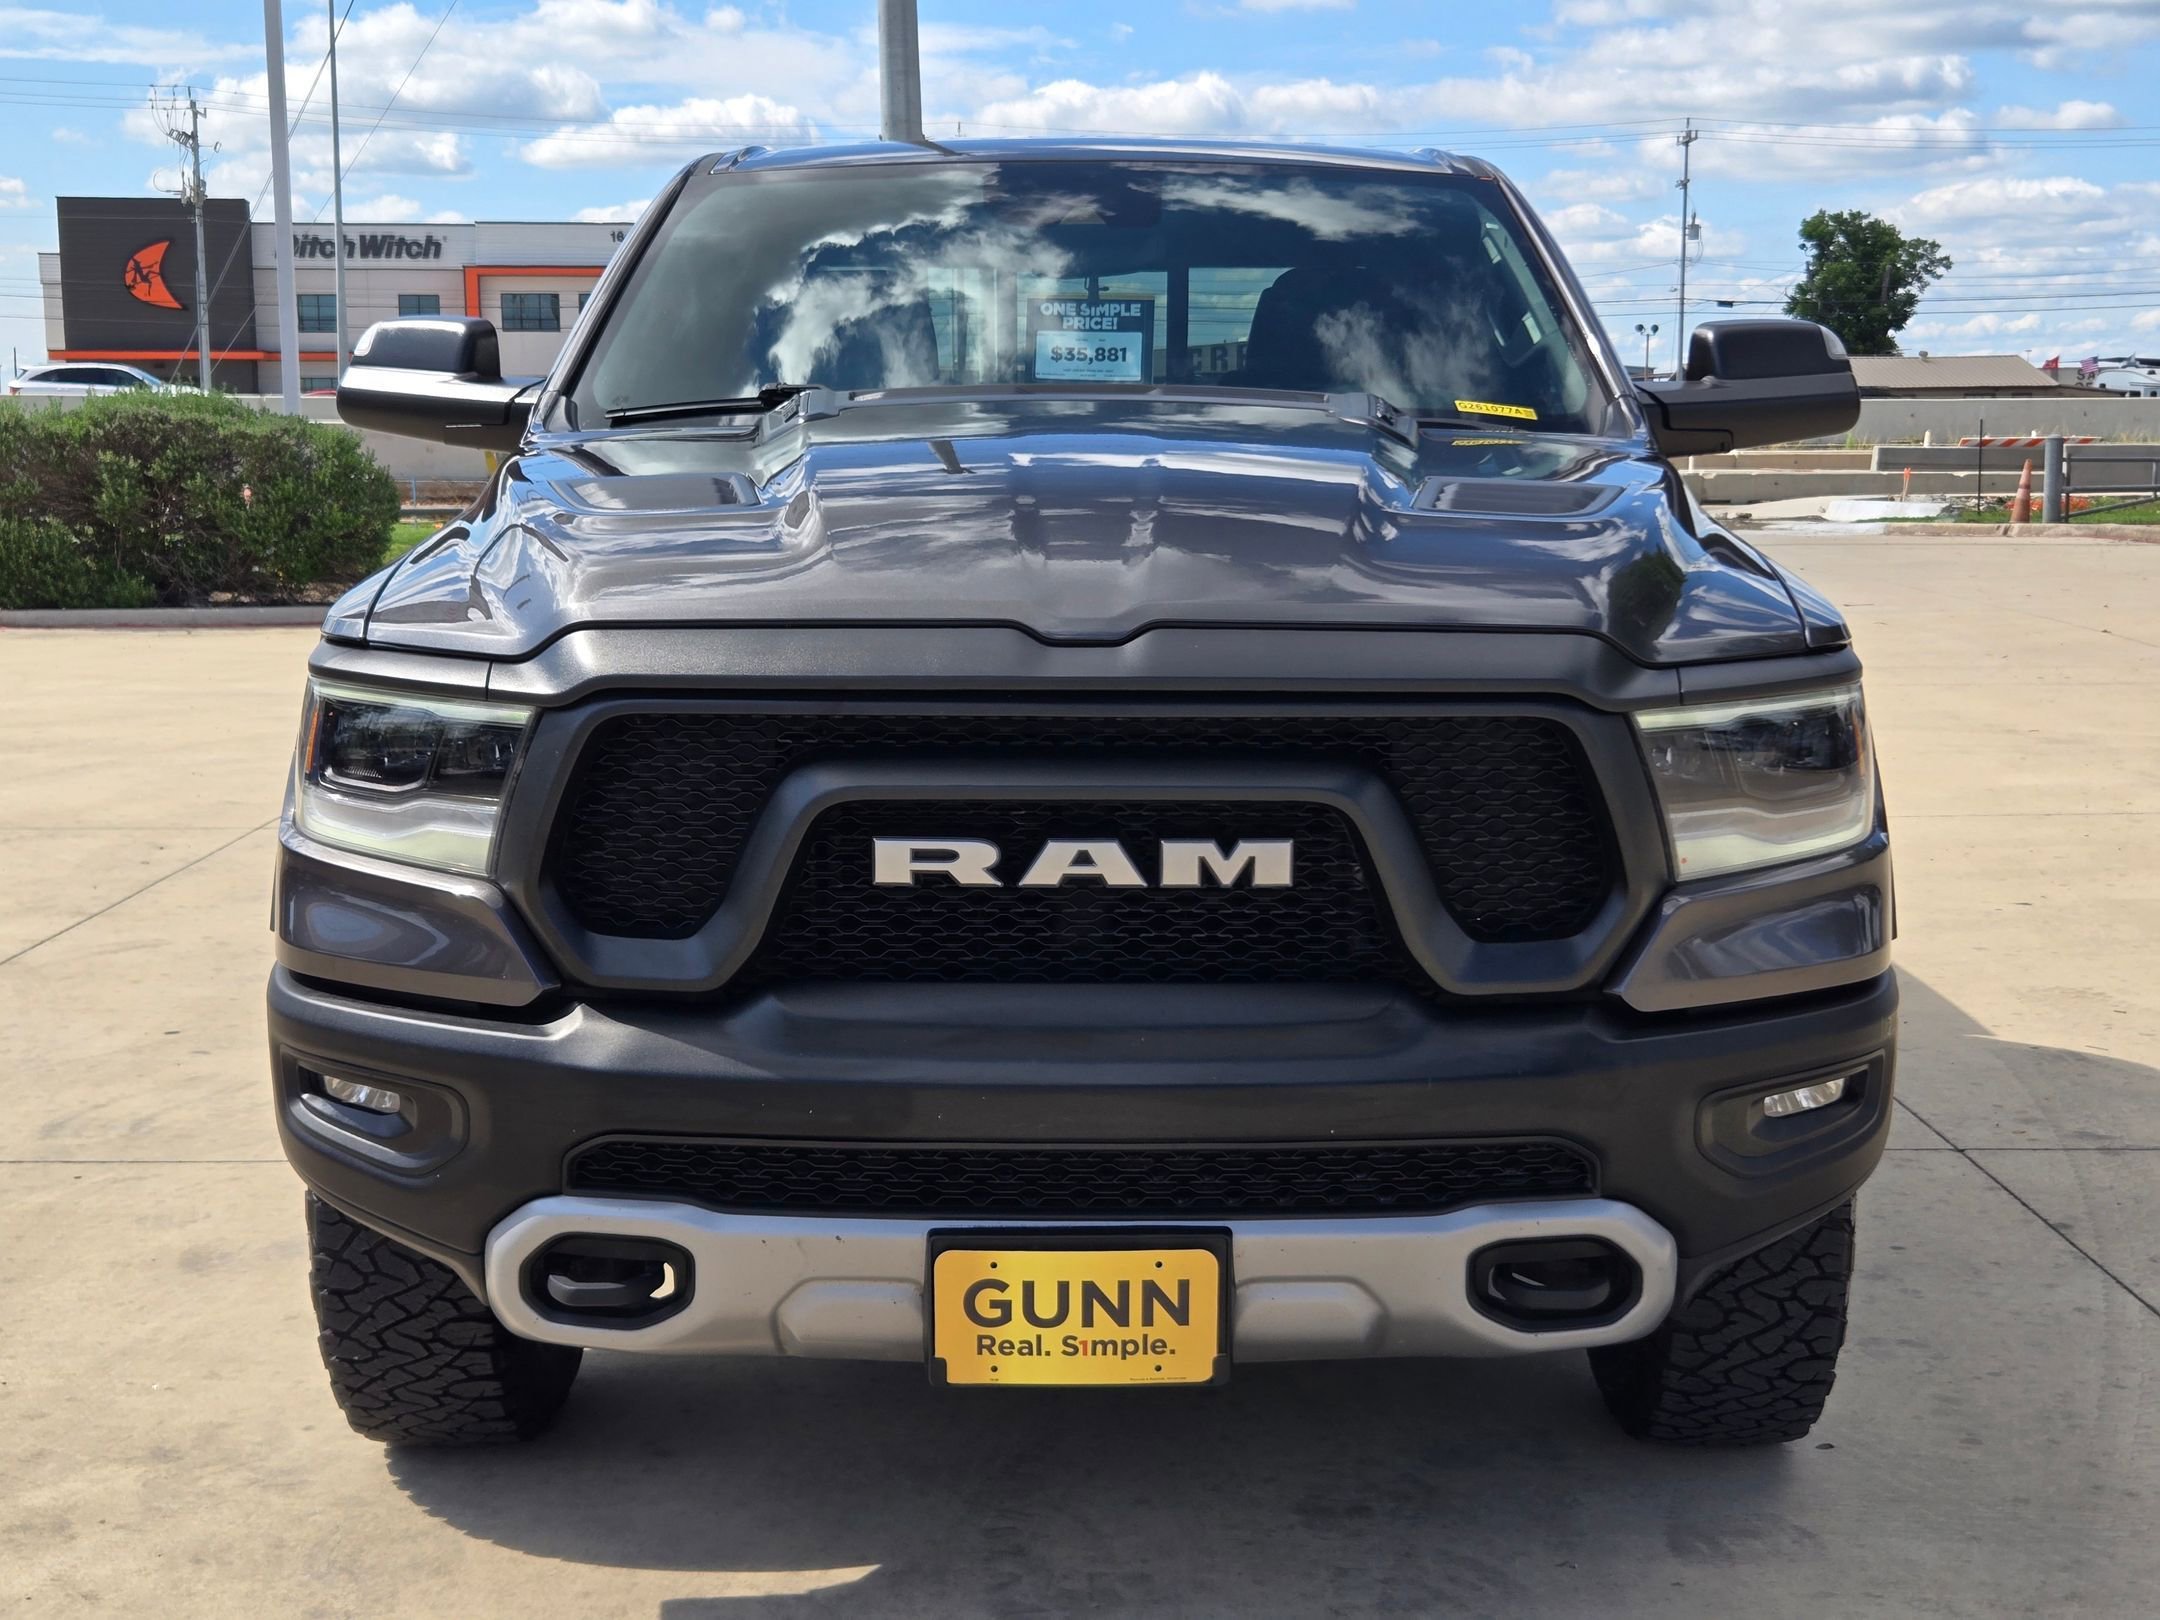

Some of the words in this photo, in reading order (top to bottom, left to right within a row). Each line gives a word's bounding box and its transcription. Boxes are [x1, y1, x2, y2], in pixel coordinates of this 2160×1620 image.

[275, 234, 356, 259] itch
[359, 234, 442, 259] Witch
[1040, 302, 1077, 316] ONE
[1062, 316, 1118, 330] PRICE!
[1050, 345, 1128, 365] $35,881
[872, 837, 1295, 888] RAM
[963, 1278, 1190, 1328] GUNN
[976, 1334, 1051, 1357] Real.
